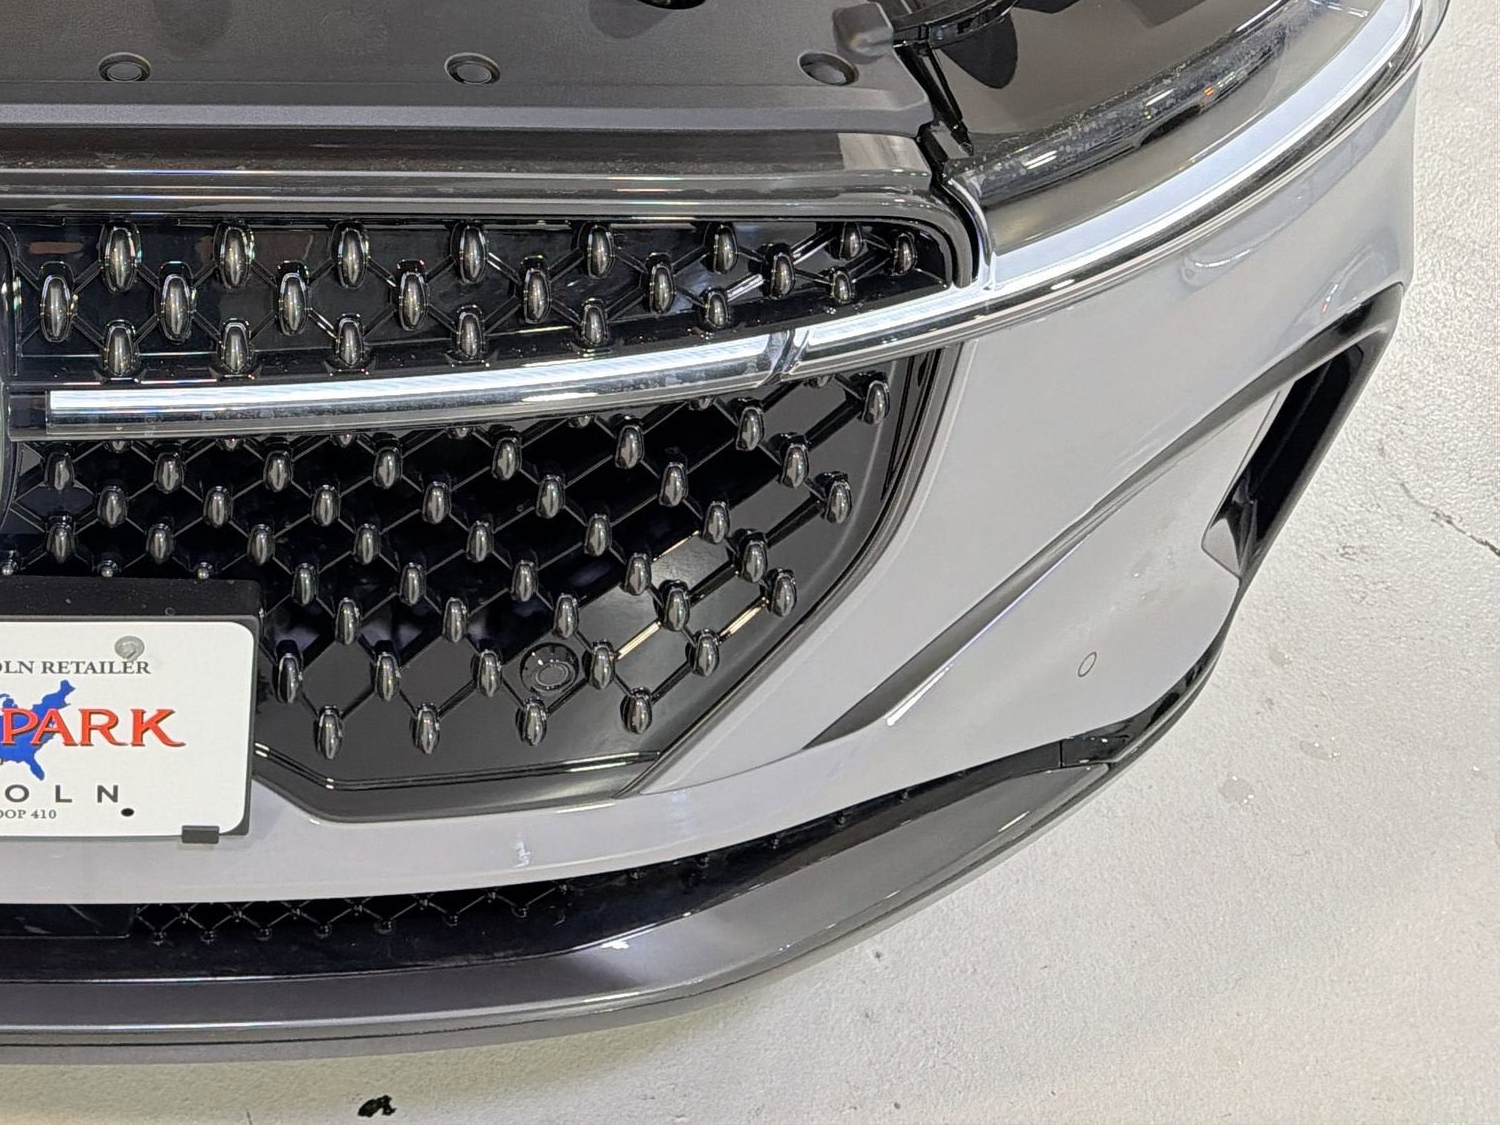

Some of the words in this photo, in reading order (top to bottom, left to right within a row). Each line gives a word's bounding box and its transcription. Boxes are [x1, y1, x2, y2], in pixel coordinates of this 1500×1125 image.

[41, 660, 152, 675] RETAILER
[0, 707, 187, 748] PARK
[30, 809, 57, 820] 410
